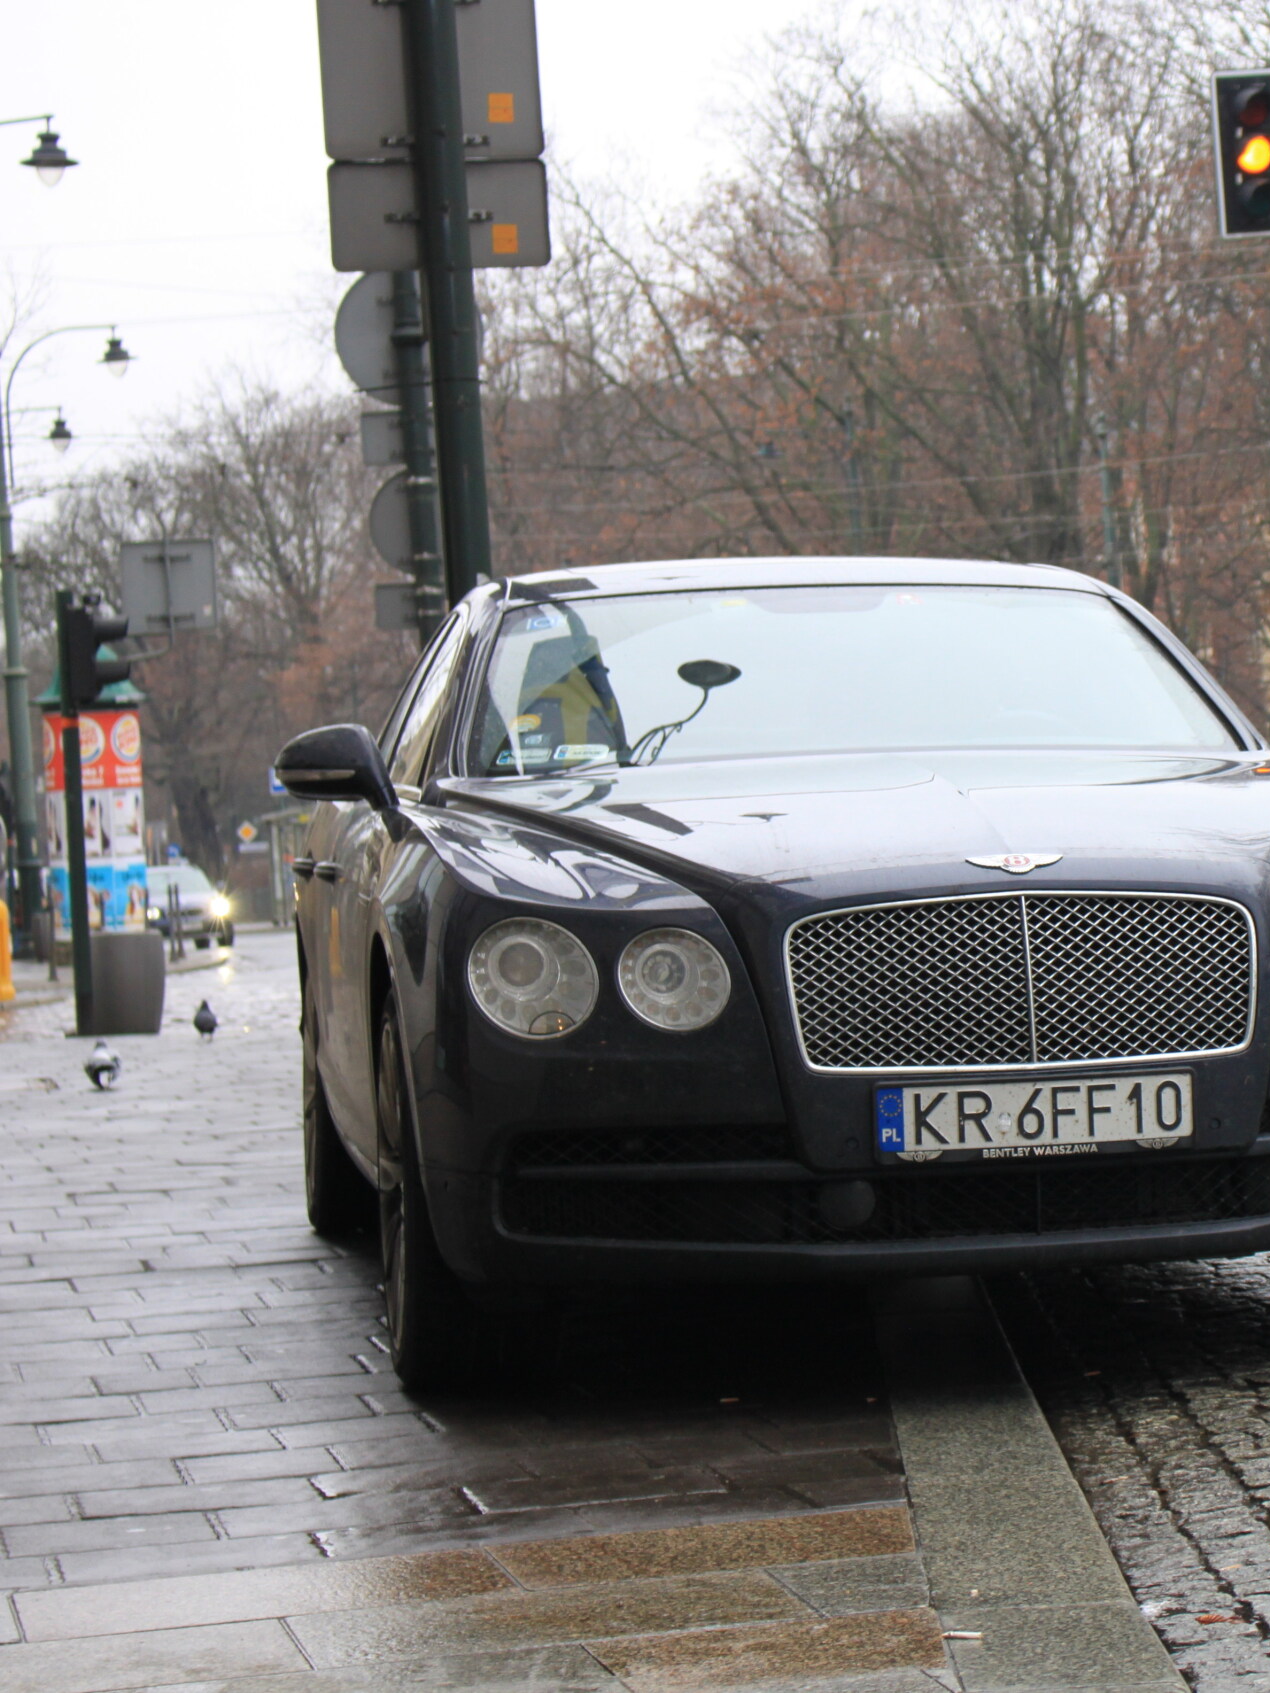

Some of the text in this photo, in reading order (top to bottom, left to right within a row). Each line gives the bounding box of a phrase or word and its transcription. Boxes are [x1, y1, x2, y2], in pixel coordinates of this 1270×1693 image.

[914, 1080, 1182, 1145] KR 6FF10
[882, 1128, 901, 1142] PL
[982, 1143, 1098, 1158] BENTLEY WARSZAWA
